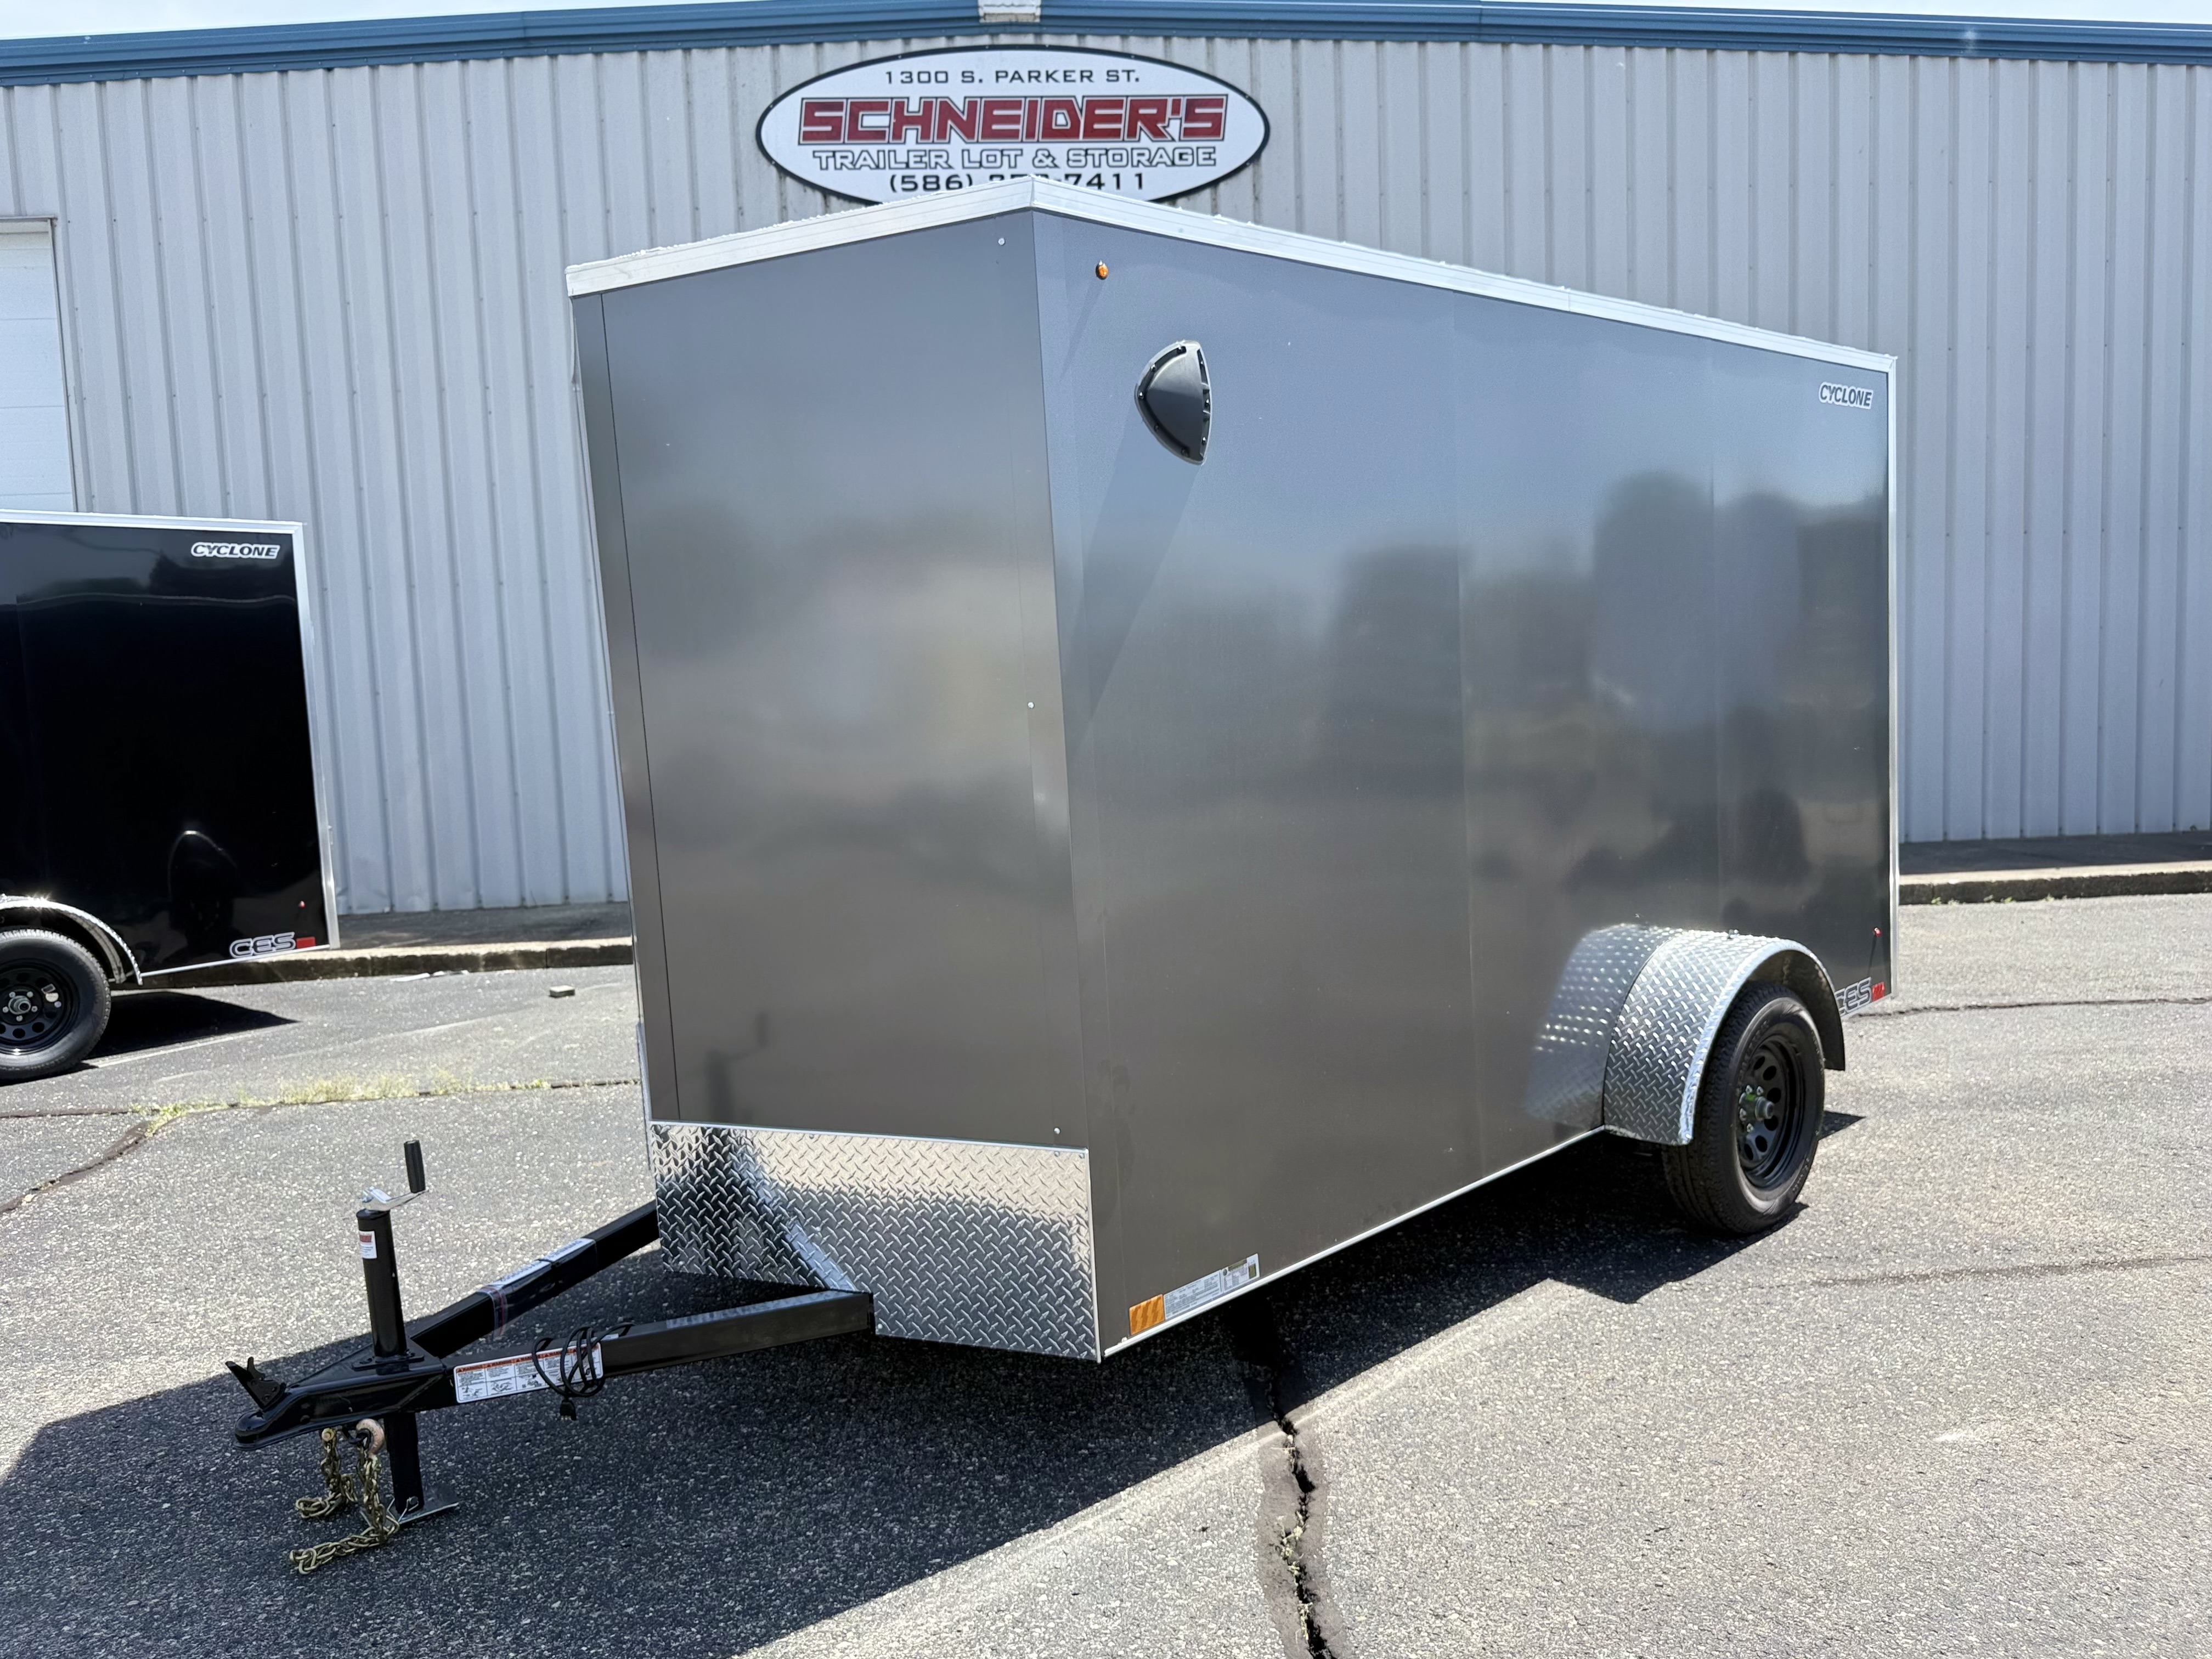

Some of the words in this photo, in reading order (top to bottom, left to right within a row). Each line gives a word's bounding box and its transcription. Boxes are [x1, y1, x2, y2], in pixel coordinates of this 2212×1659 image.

[885, 70, 949, 84] 1300
[961, 70, 983, 84] S.
[995, 69, 1094, 84] PARKER
[1105, 69, 1140, 83] ST.
[798, 94, 1229, 145] SCHNEIDER'S
[812, 149, 955, 171] TRAILER
[961, 148, 1023, 170] LOT
[1032, 148, 1060, 168] &
[1066, 146, 1216, 168] STORAGE
[889, 173, 973, 193] (586)
[989, 173, 1144, 190] -7411
[1819, 383, 1873, 408] CYCLONE
[191, 543, 280, 558] CYCLONE
[229, 932, 296, 958] CES
